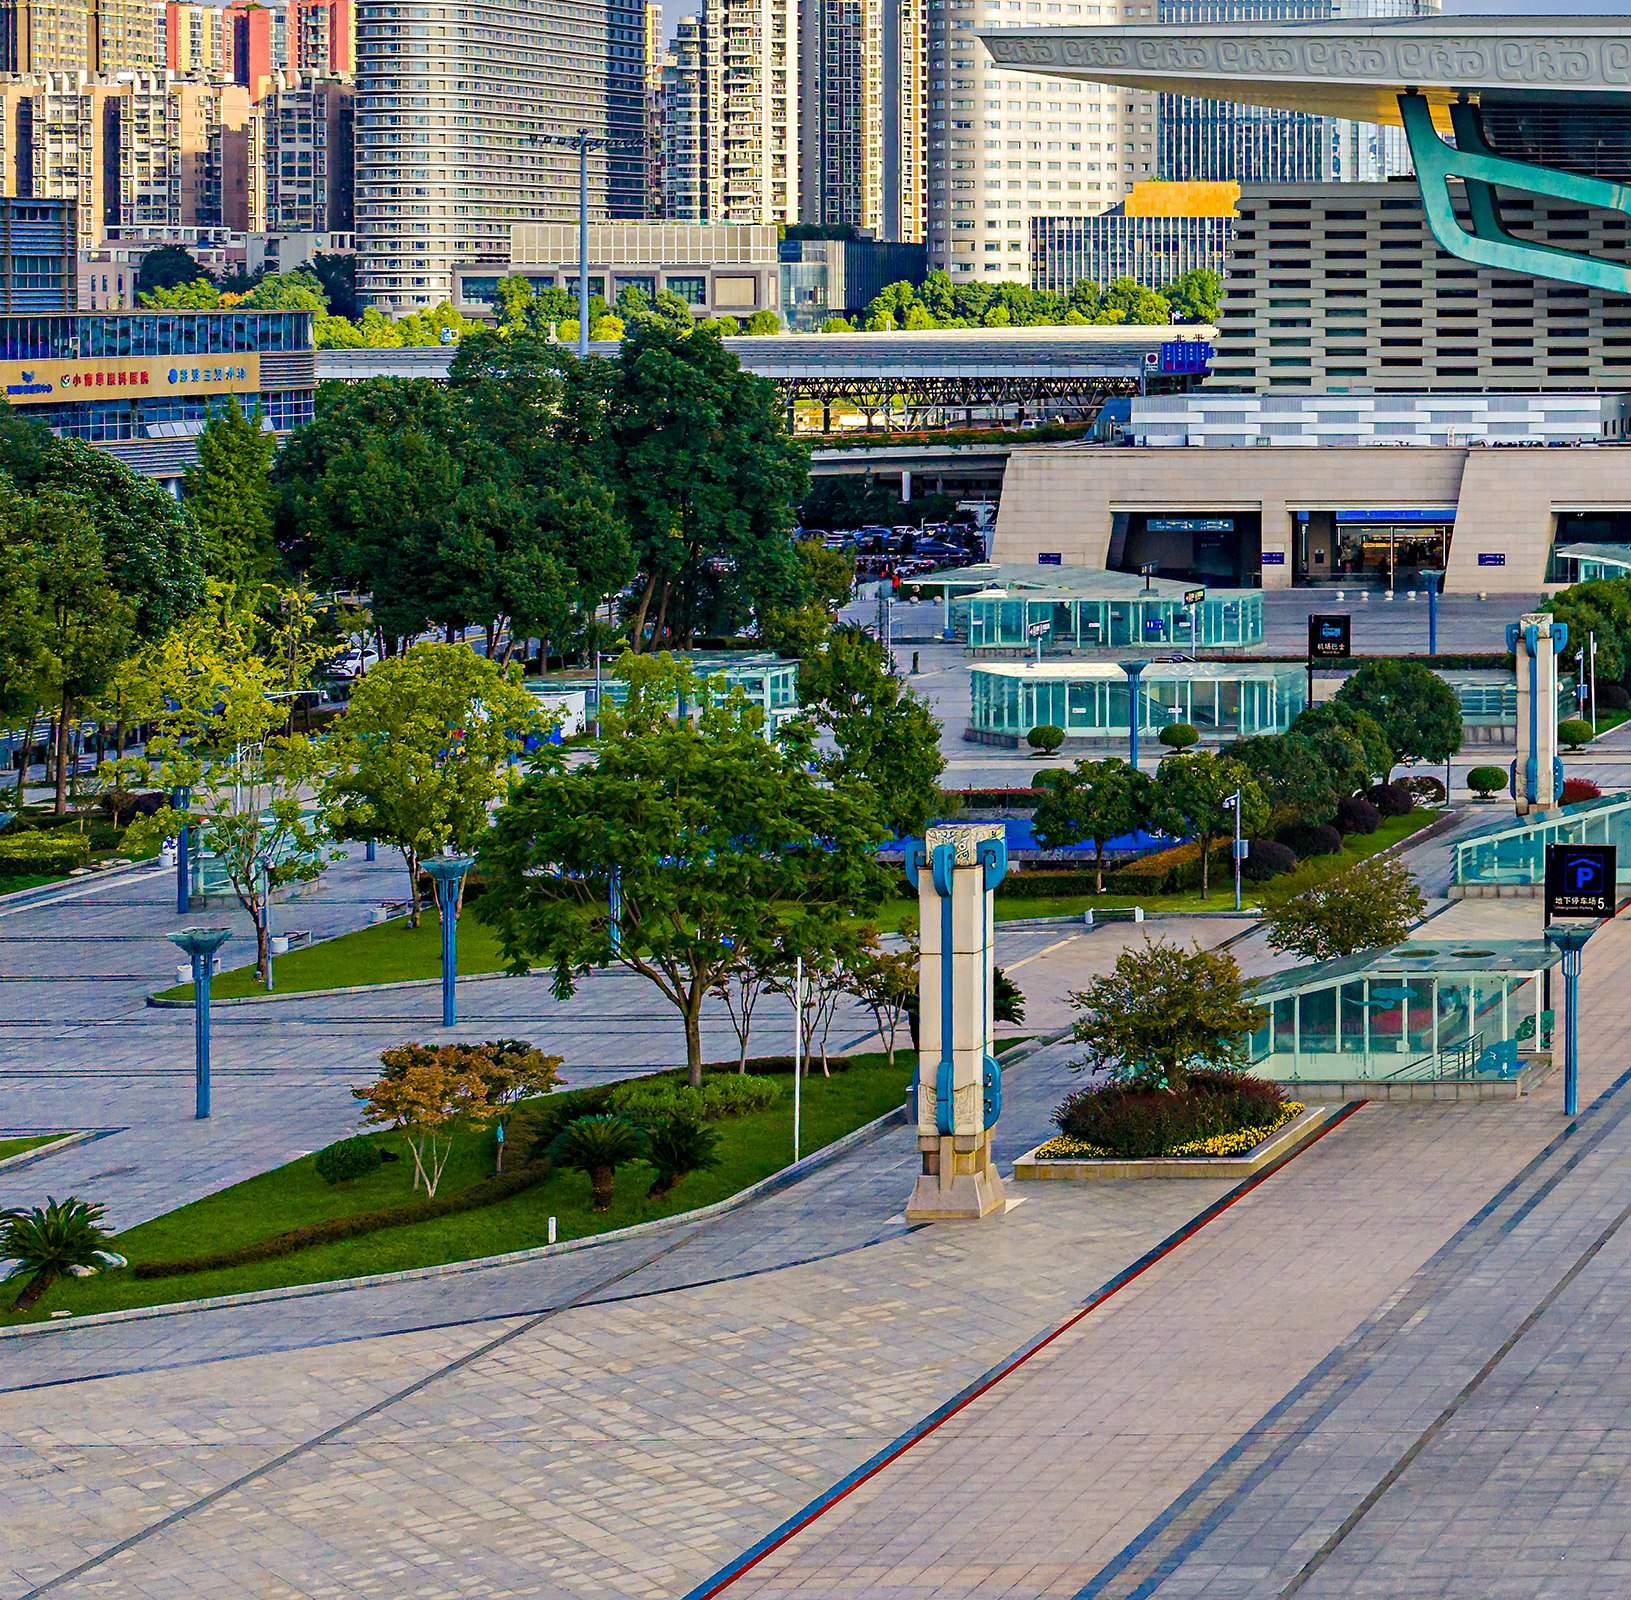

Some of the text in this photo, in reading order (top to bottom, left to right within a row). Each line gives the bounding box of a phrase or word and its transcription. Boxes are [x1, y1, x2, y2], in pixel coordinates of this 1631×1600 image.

[1317, 642, 1346, 651] 机场巴士
[1555, 897, 1597, 905] 地下停车场
[1597, 897, 1605, 910] 5
